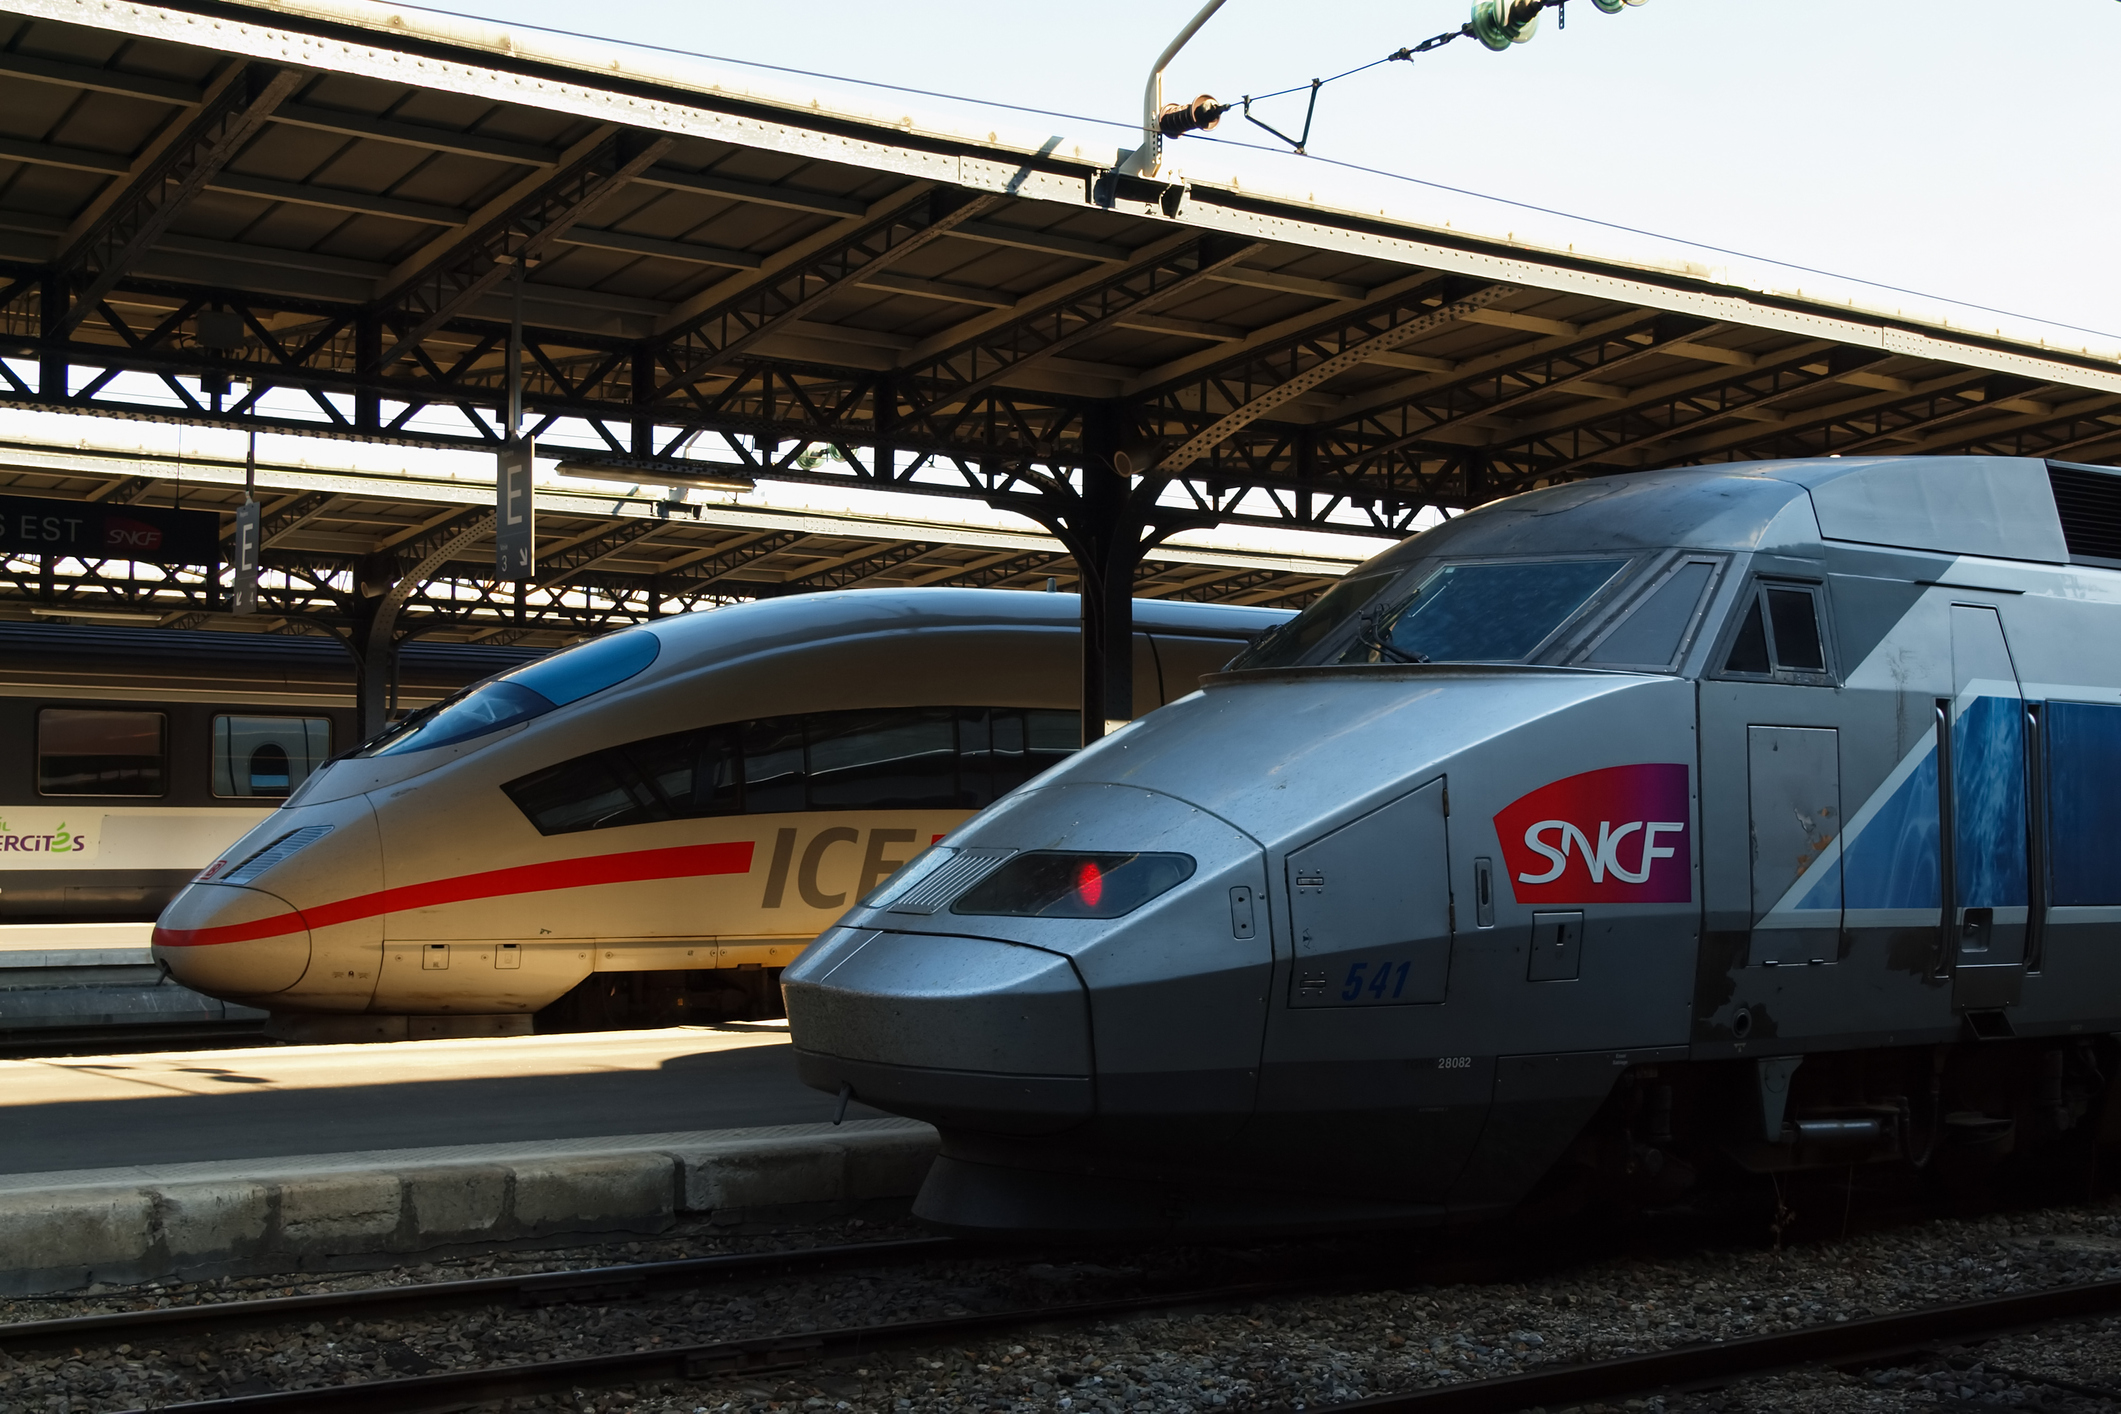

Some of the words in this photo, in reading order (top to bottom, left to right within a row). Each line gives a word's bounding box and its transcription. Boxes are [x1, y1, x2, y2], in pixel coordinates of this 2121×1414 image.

[507, 464, 522, 525] E
[20, 515, 83, 542] EST
[107, 529, 161, 546] SNCF
[242, 523, 254, 571] E
[501, 555, 508, 572] 3
[1517, 819, 1685, 884] SNCF
[1341, 961, 1412, 1001] 541
[1438, 1056, 1471, 1069] 28082
